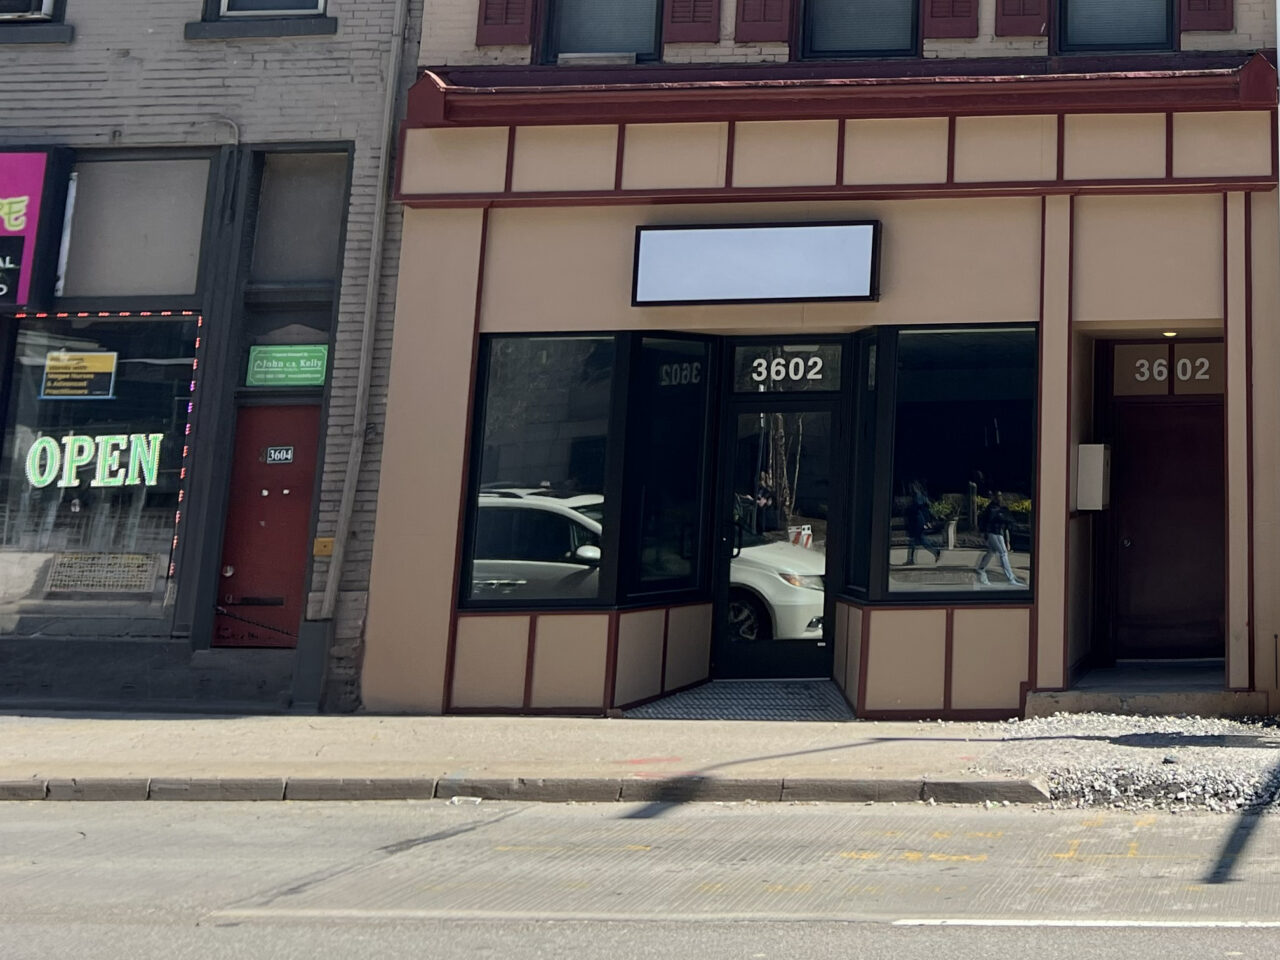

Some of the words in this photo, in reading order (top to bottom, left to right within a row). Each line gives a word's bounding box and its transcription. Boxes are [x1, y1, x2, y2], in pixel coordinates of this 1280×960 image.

[263, 359, 284, 369] John
[300, 358, 323, 369] Kelly
[751, 356, 824, 382] 3602
[25, 432, 164, 489] OPEN
[267, 449, 292, 461] 3604
